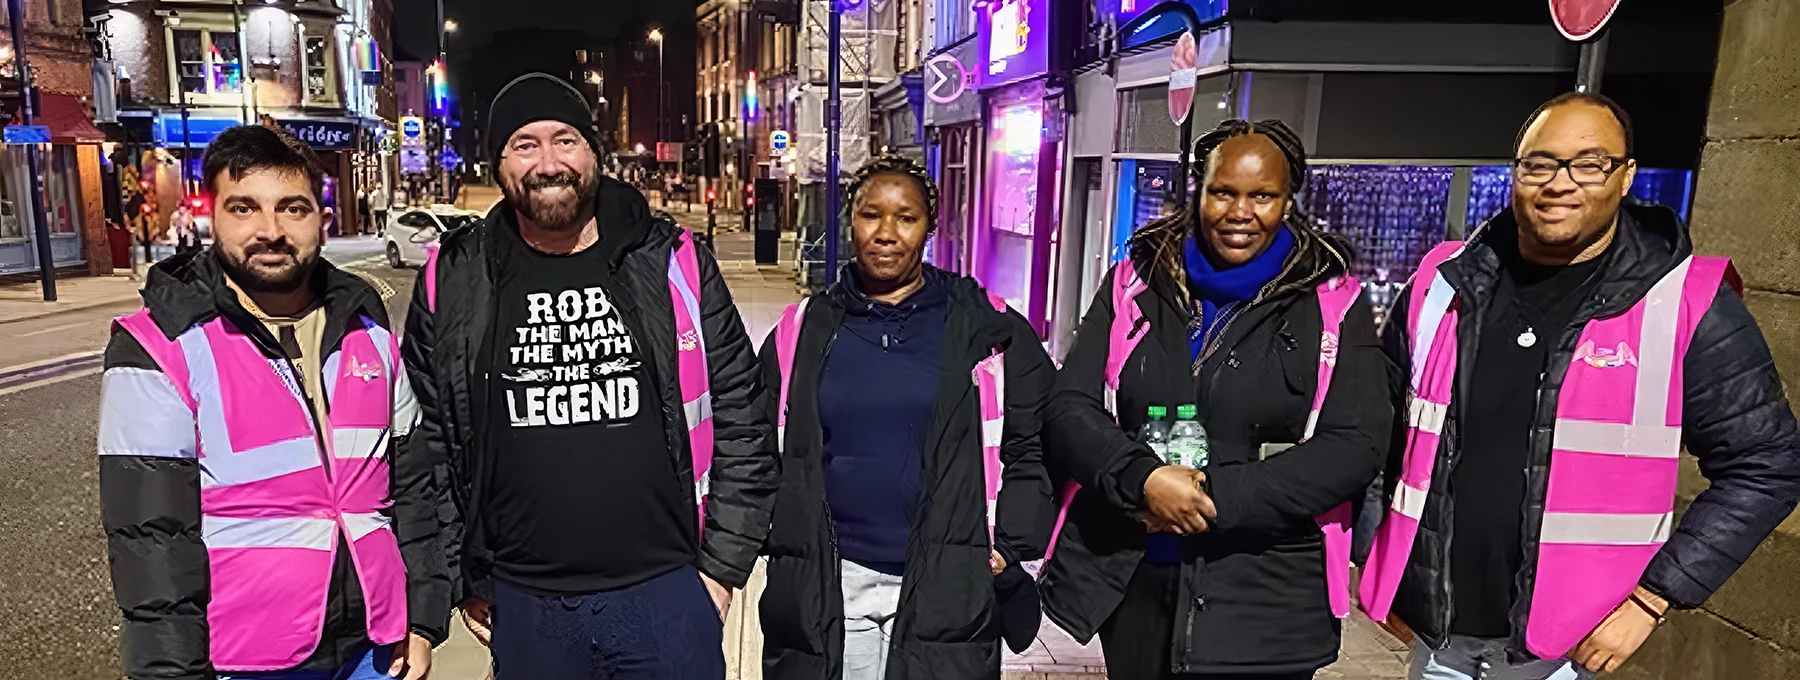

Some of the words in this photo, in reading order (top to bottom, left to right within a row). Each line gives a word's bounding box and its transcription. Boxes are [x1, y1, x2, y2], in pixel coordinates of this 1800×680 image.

[527, 287, 611, 324] ROB
[516, 325, 562, 344] THE
[569, 318, 625, 342] MAN
[510, 345, 554, 364] THE
[562, 336, 633, 362] MYTH
[552, 363, 590, 382] THE
[506, 377, 639, 426] LEGEND
